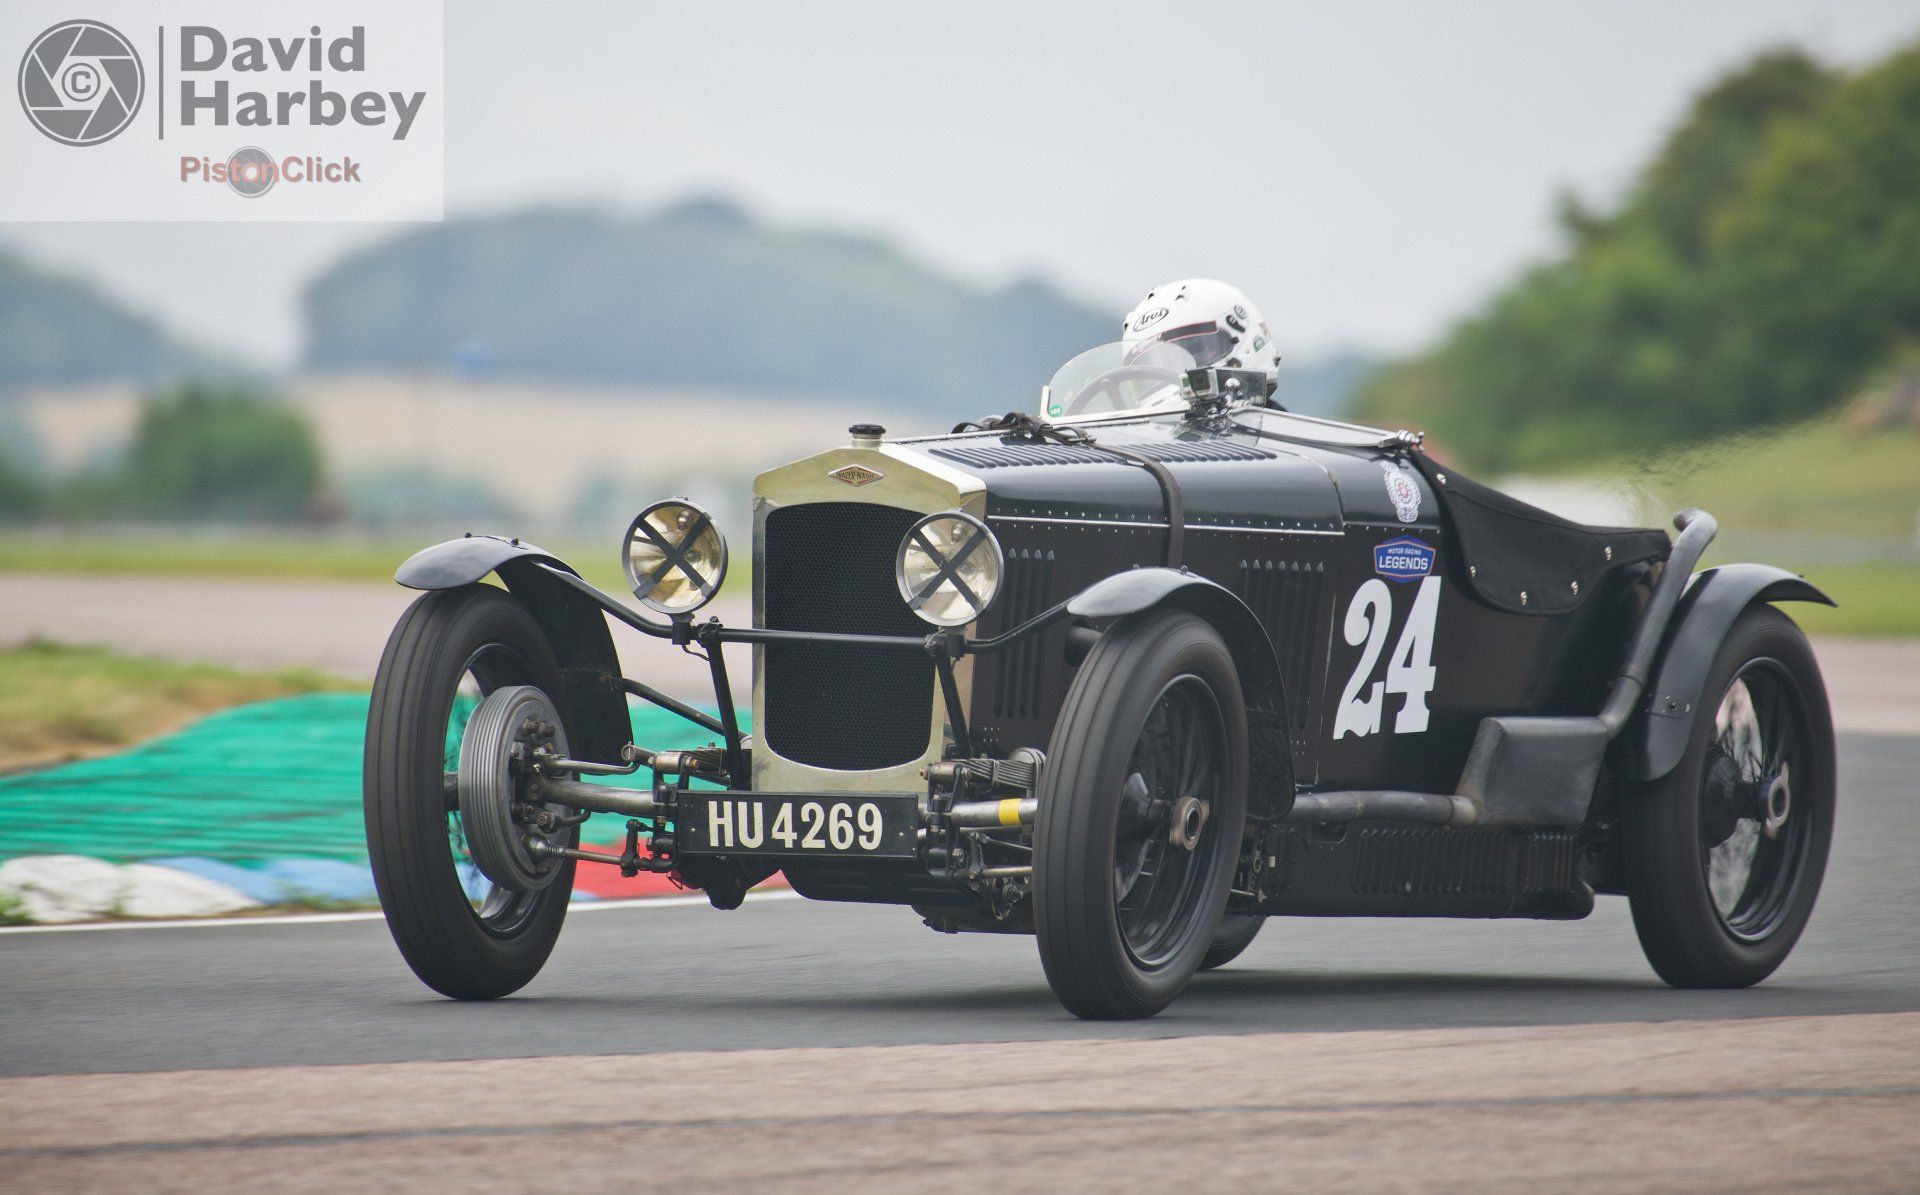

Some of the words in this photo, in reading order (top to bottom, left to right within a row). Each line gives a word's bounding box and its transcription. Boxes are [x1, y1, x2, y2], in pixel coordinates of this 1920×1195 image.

[1379, 556, 1428, 570] LEGENDS
[1333, 576, 1442, 739] 24
[708, 801, 764, 848] HU
[771, 802, 883, 850] 4269
